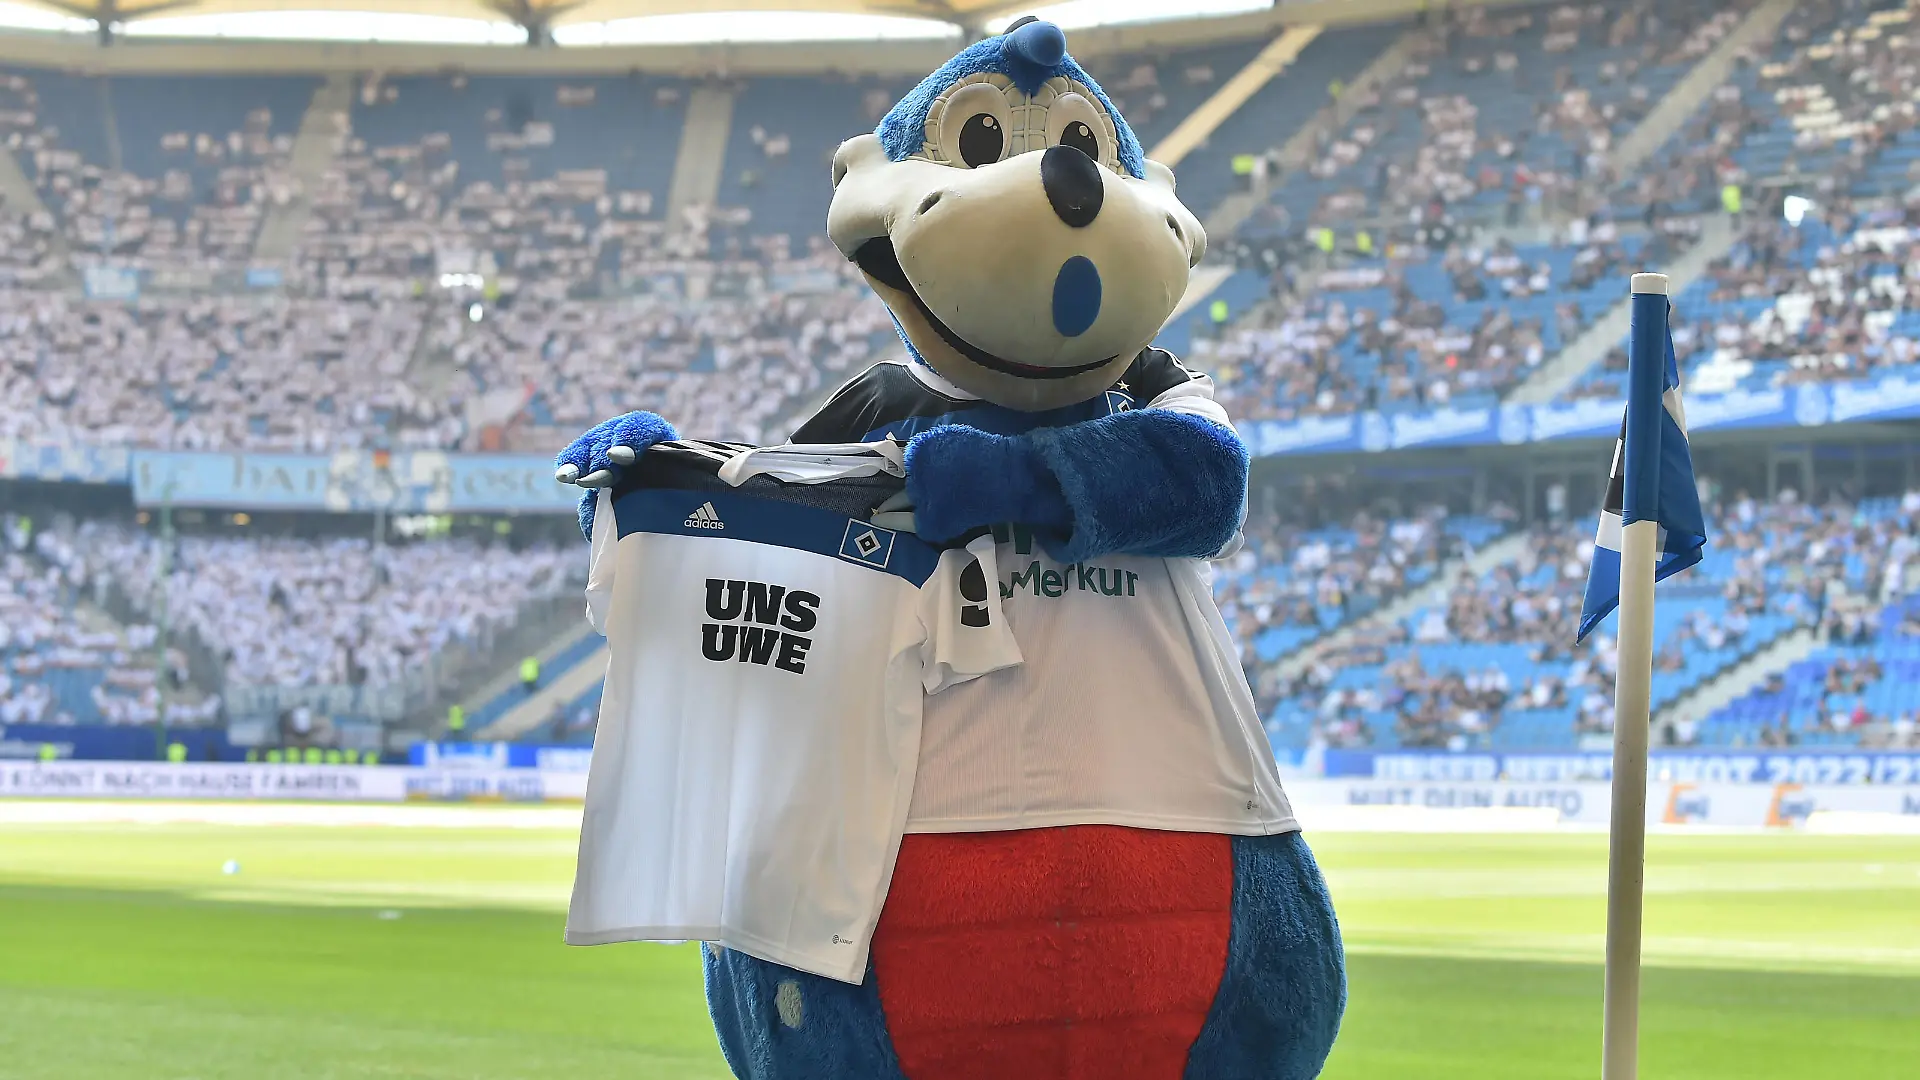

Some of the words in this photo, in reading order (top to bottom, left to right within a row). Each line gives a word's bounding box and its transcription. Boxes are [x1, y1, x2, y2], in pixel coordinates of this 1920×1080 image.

[684, 518, 725, 530] adidas
[705, 578, 821, 633] UNS
[701, 623, 812, 675] UWE
[1763, 756, 1920, 782] 2022/2
